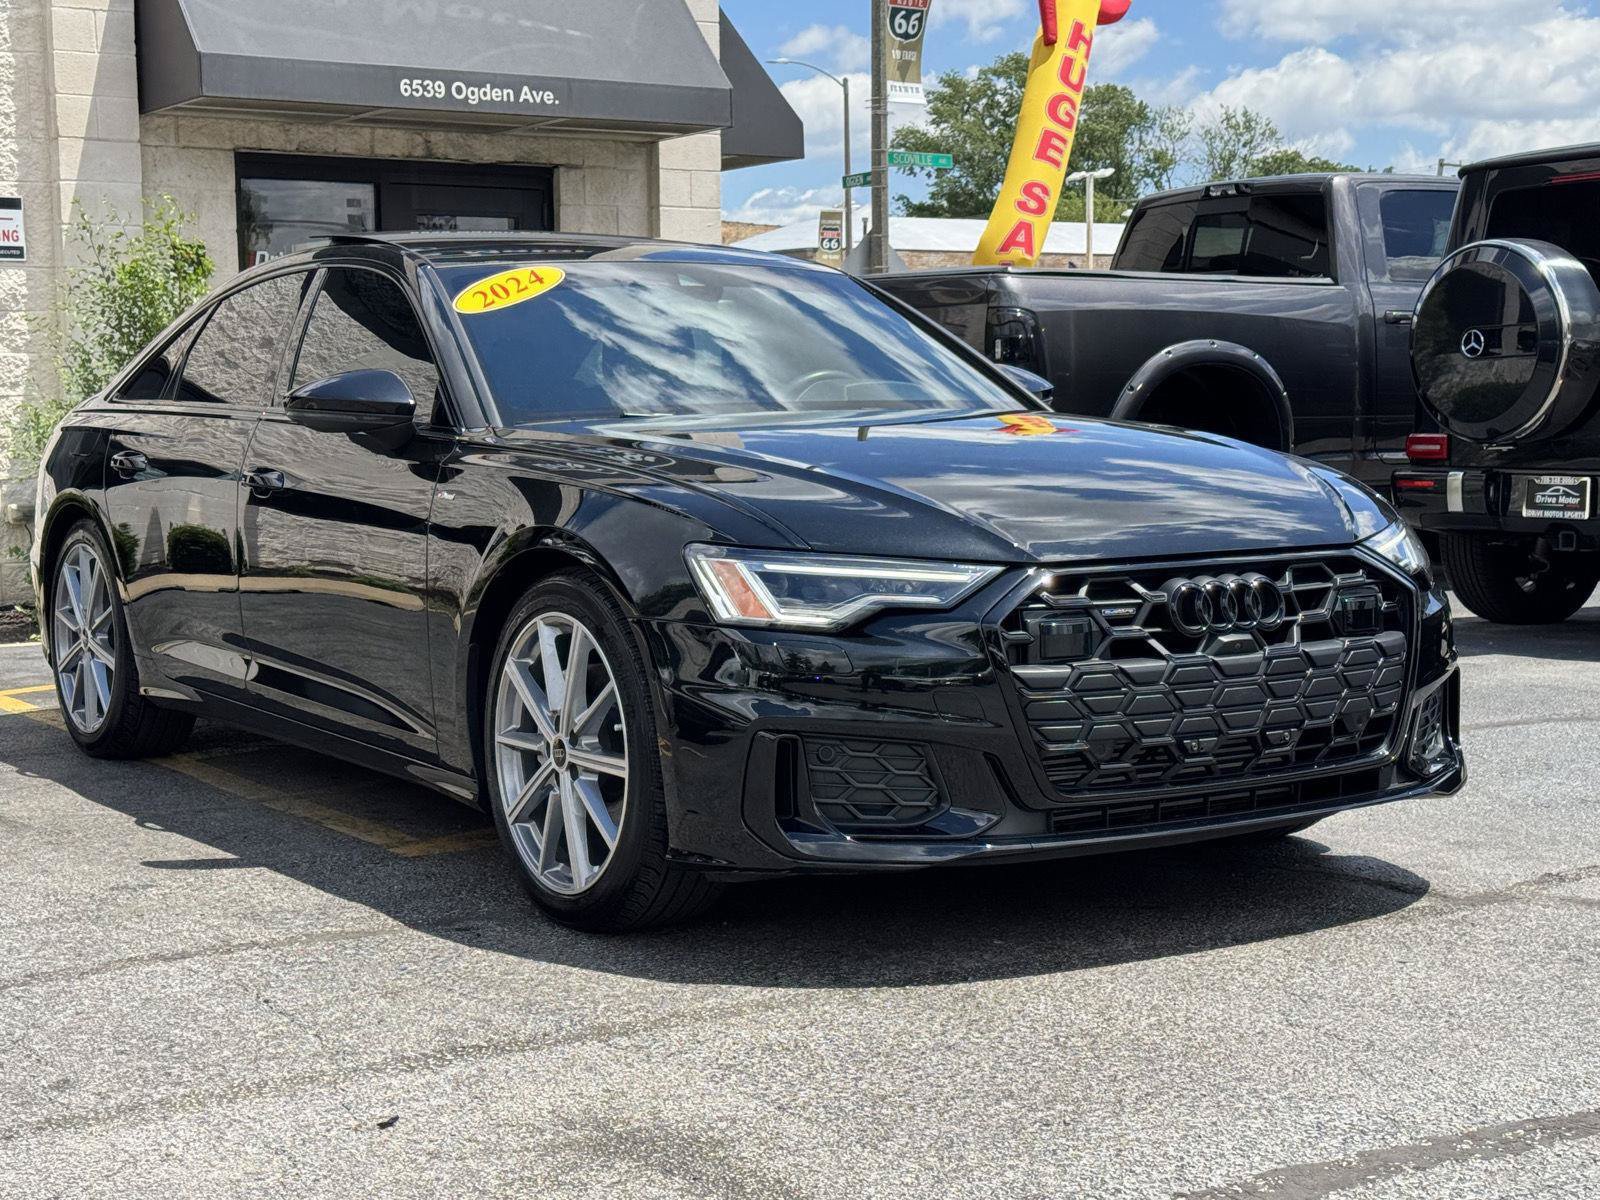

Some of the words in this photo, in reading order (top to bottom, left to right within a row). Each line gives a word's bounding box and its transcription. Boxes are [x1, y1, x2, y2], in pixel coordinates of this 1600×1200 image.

[894, 10, 921, 35] 66
[400, 79, 445, 98] 6539
[451, 81, 514, 104] Ogden
[518, 85, 560, 105] Ave.
[1033, 19, 1093, 170] HUGE
[893, 153, 933, 166] SCOVILLE
[0, 229, 20, 242] NG
[996, 180, 1050, 266] SA
[822, 238, 839, 249] 66
[472, 269, 545, 308] 2024
[1535, 495, 1556, 503] Drive
[1558, 495, 1580, 504] Motor
